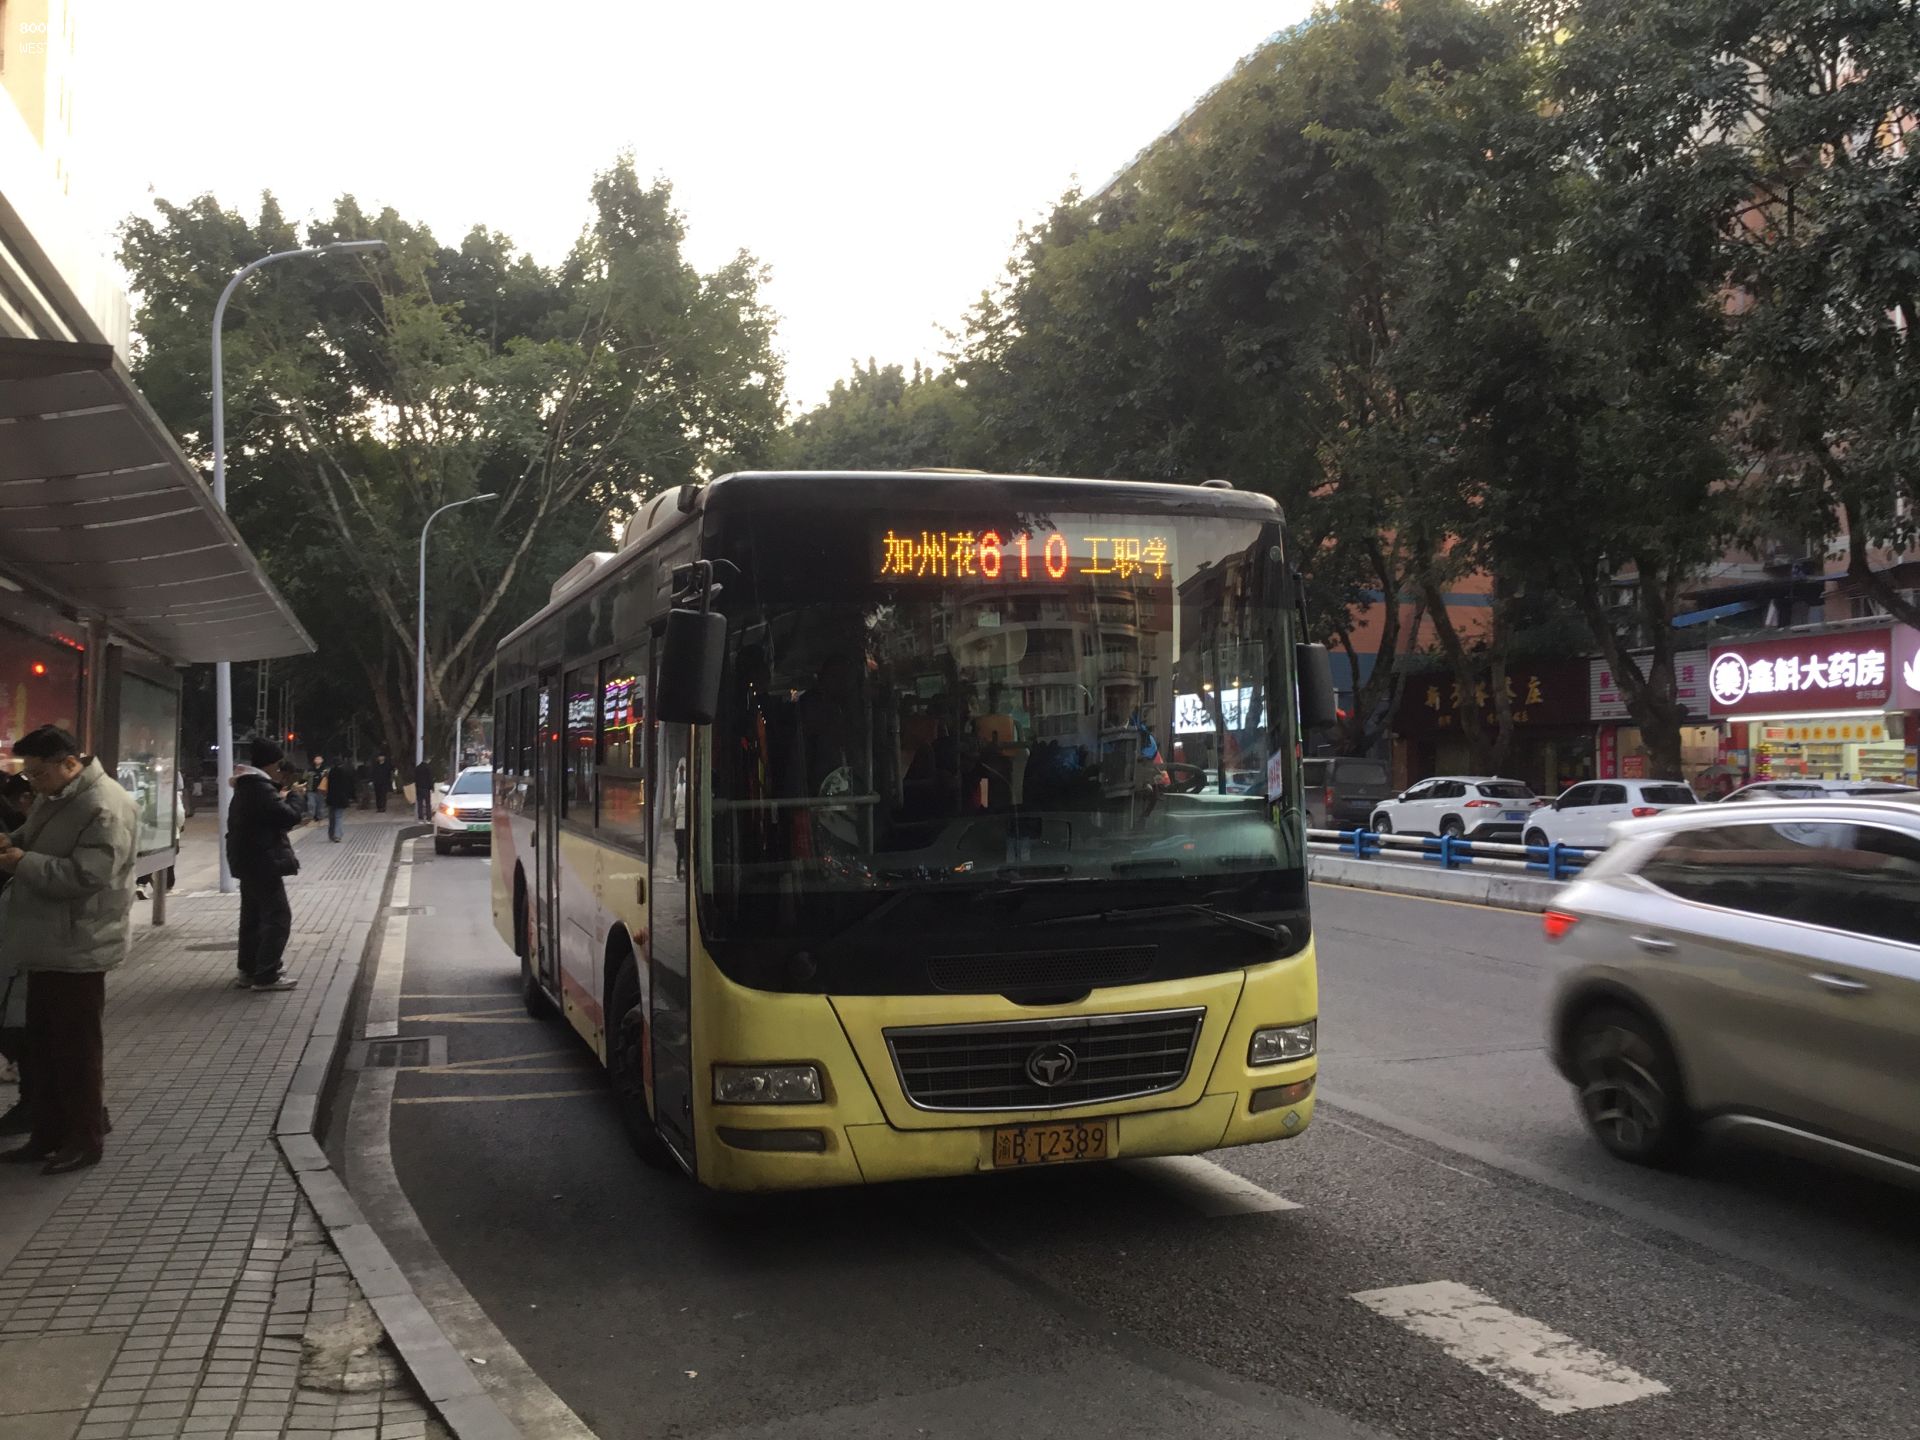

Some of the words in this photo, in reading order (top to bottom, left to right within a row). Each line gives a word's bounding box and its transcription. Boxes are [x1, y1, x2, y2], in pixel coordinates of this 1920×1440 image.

[880, 529, 977, 578] 加州花
[979, 530, 1070, 579] 610
[1080, 535, 1169, 580] 工职学
